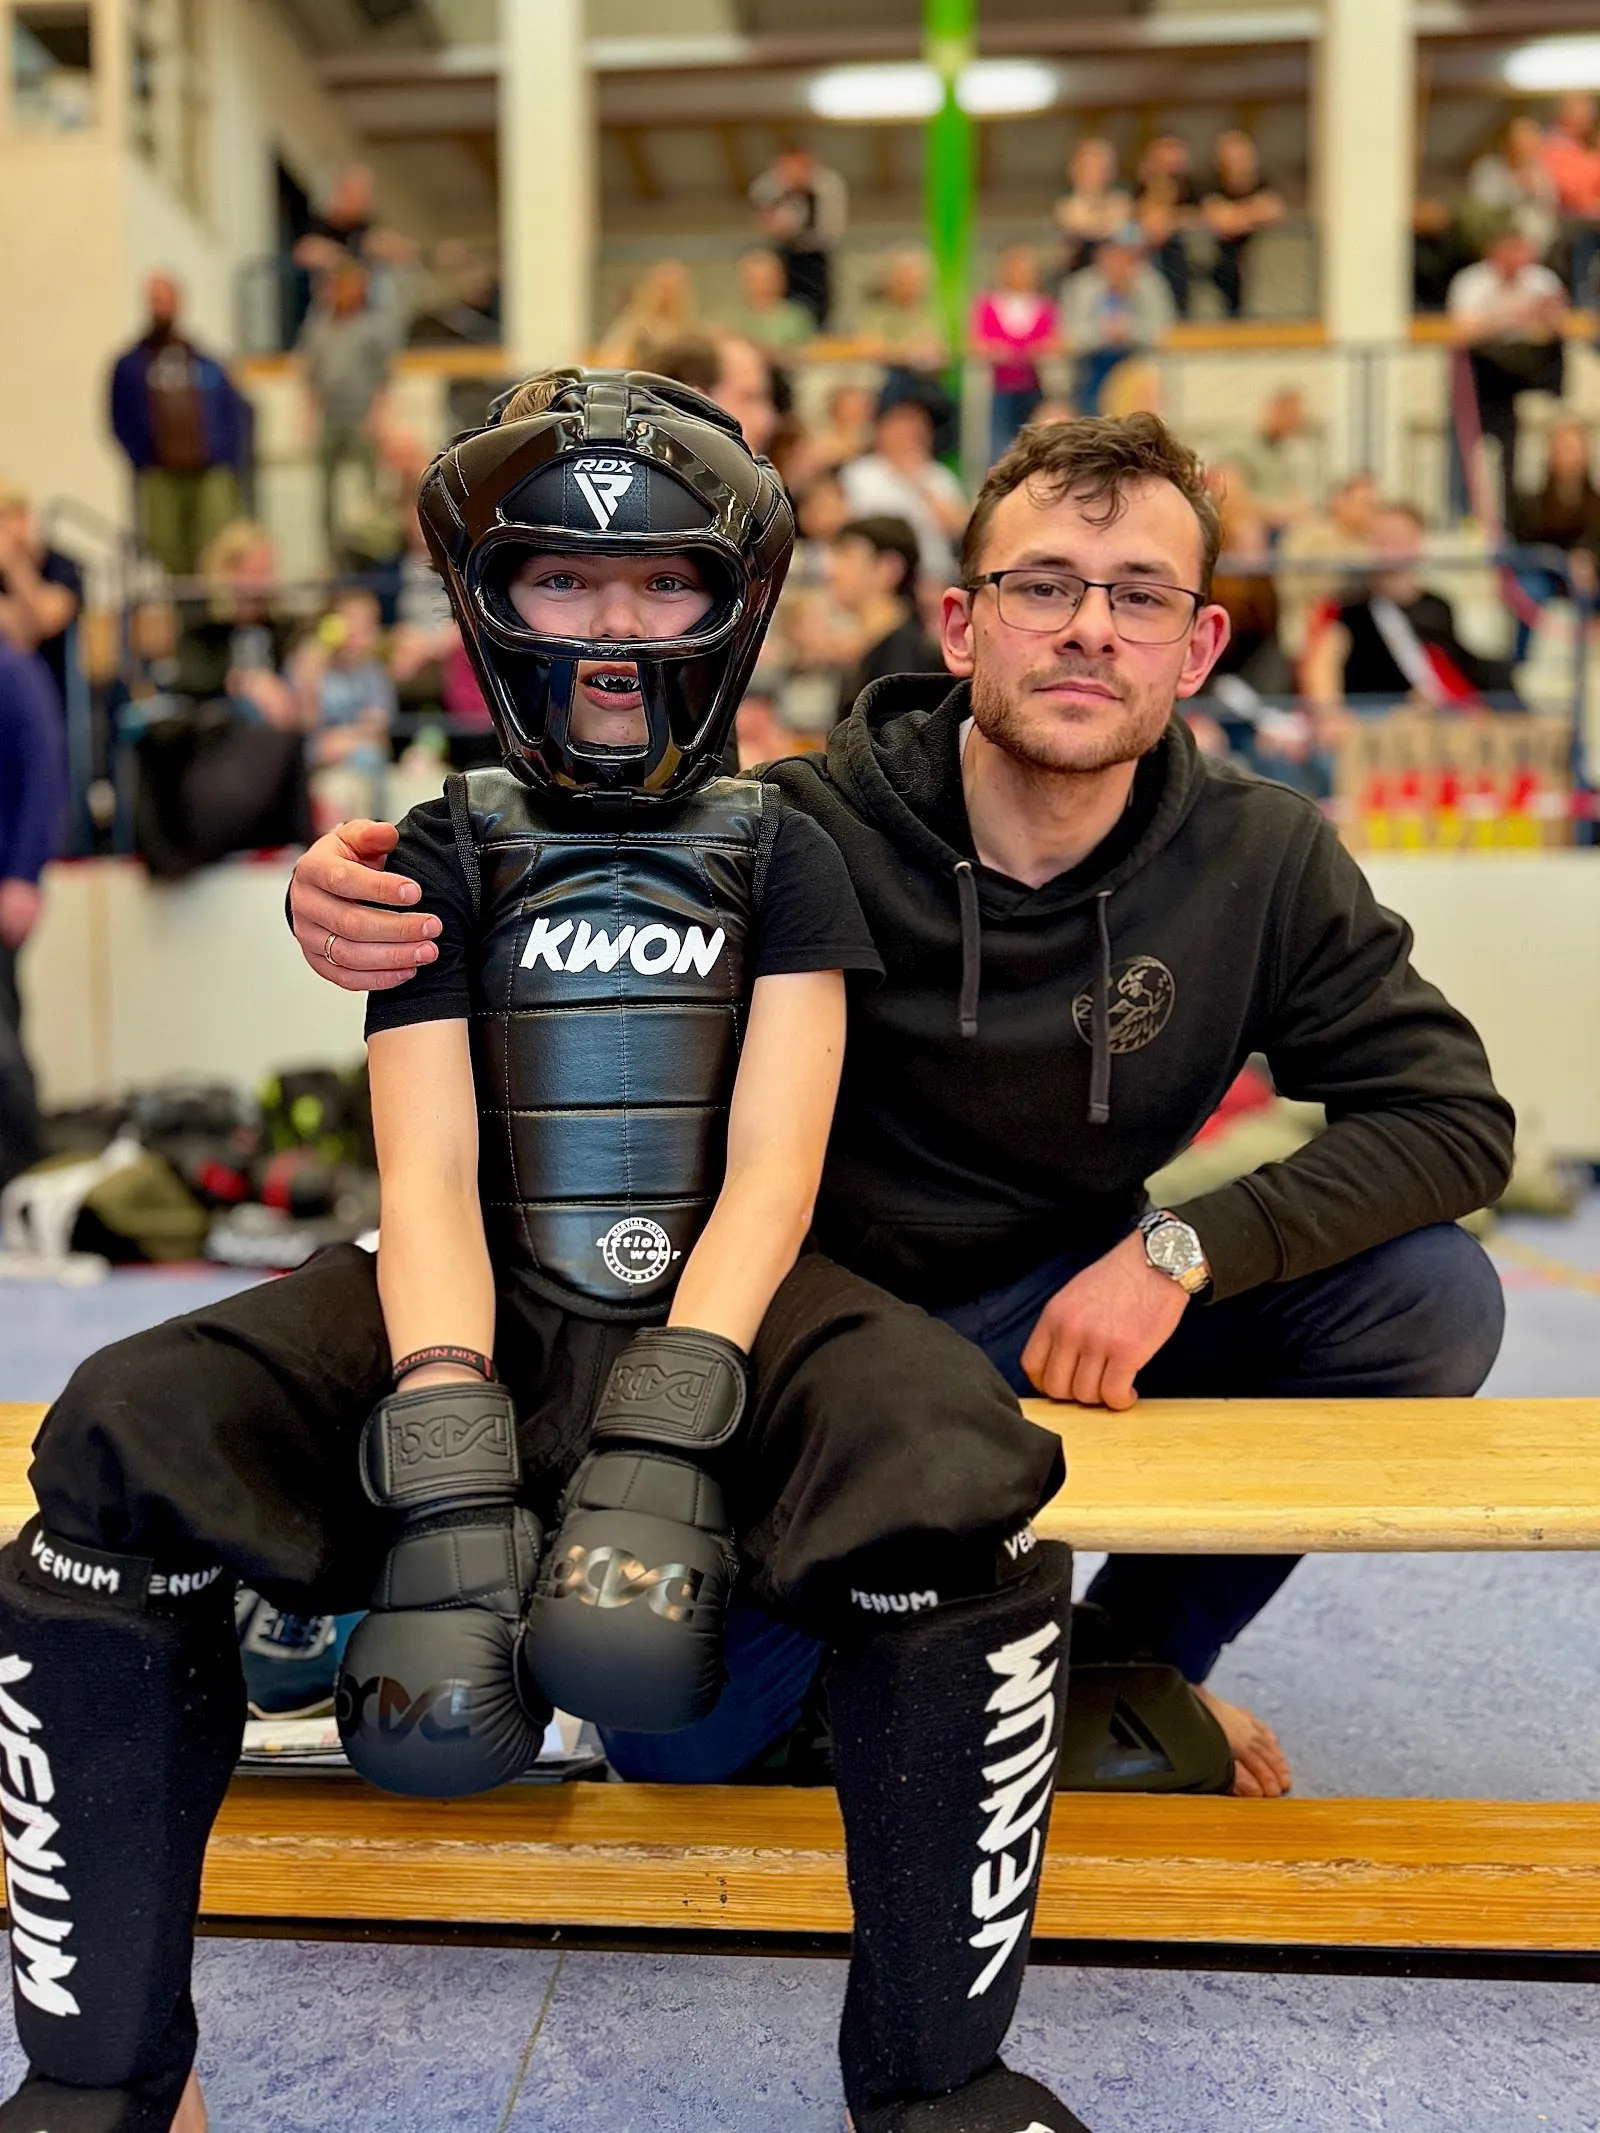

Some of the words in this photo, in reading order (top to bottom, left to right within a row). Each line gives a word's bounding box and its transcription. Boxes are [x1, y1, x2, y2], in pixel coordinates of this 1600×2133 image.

[573, 459, 636, 473] RDX
[519, 917, 725, 978] KWON
[611, 1220, 644, 1238] MARTIAL
[29, 1529, 121, 1594] VENUM
[967, 1620, 1061, 1999] VENUM
